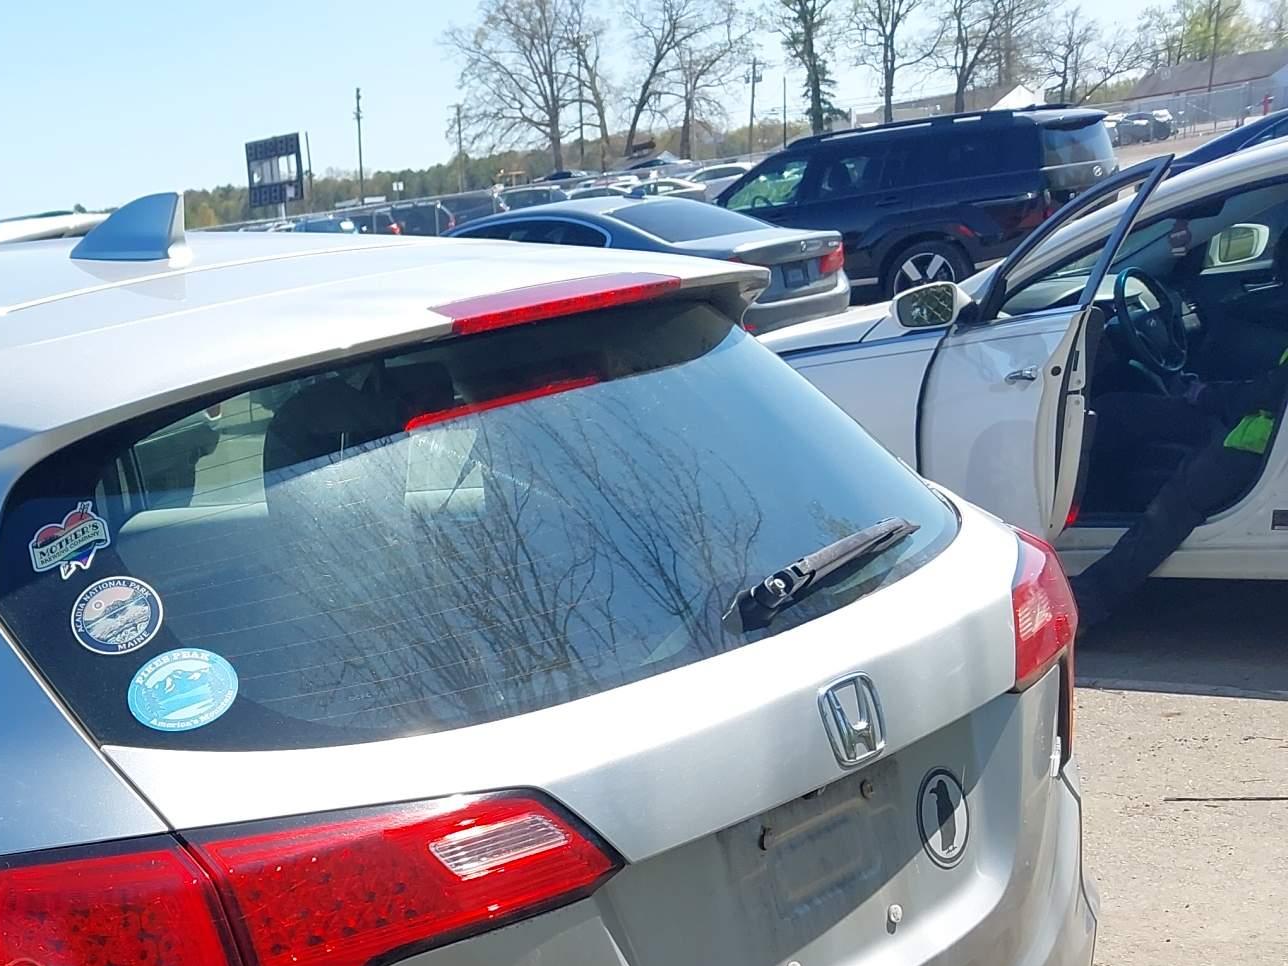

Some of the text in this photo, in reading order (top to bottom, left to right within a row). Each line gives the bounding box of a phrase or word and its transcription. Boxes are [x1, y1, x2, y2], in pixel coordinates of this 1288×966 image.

[38, 521, 100, 560] MOTHER'S
[39, 531, 101, 566] BREWING COMPANY
[75, 580, 152, 633] ACADIA NATIONAL PARK
[117, 630, 151, 652] MAINE
[135, 650, 211, 686] PIKES PEAK
[149, 689, 234, 730] America's Mountain
